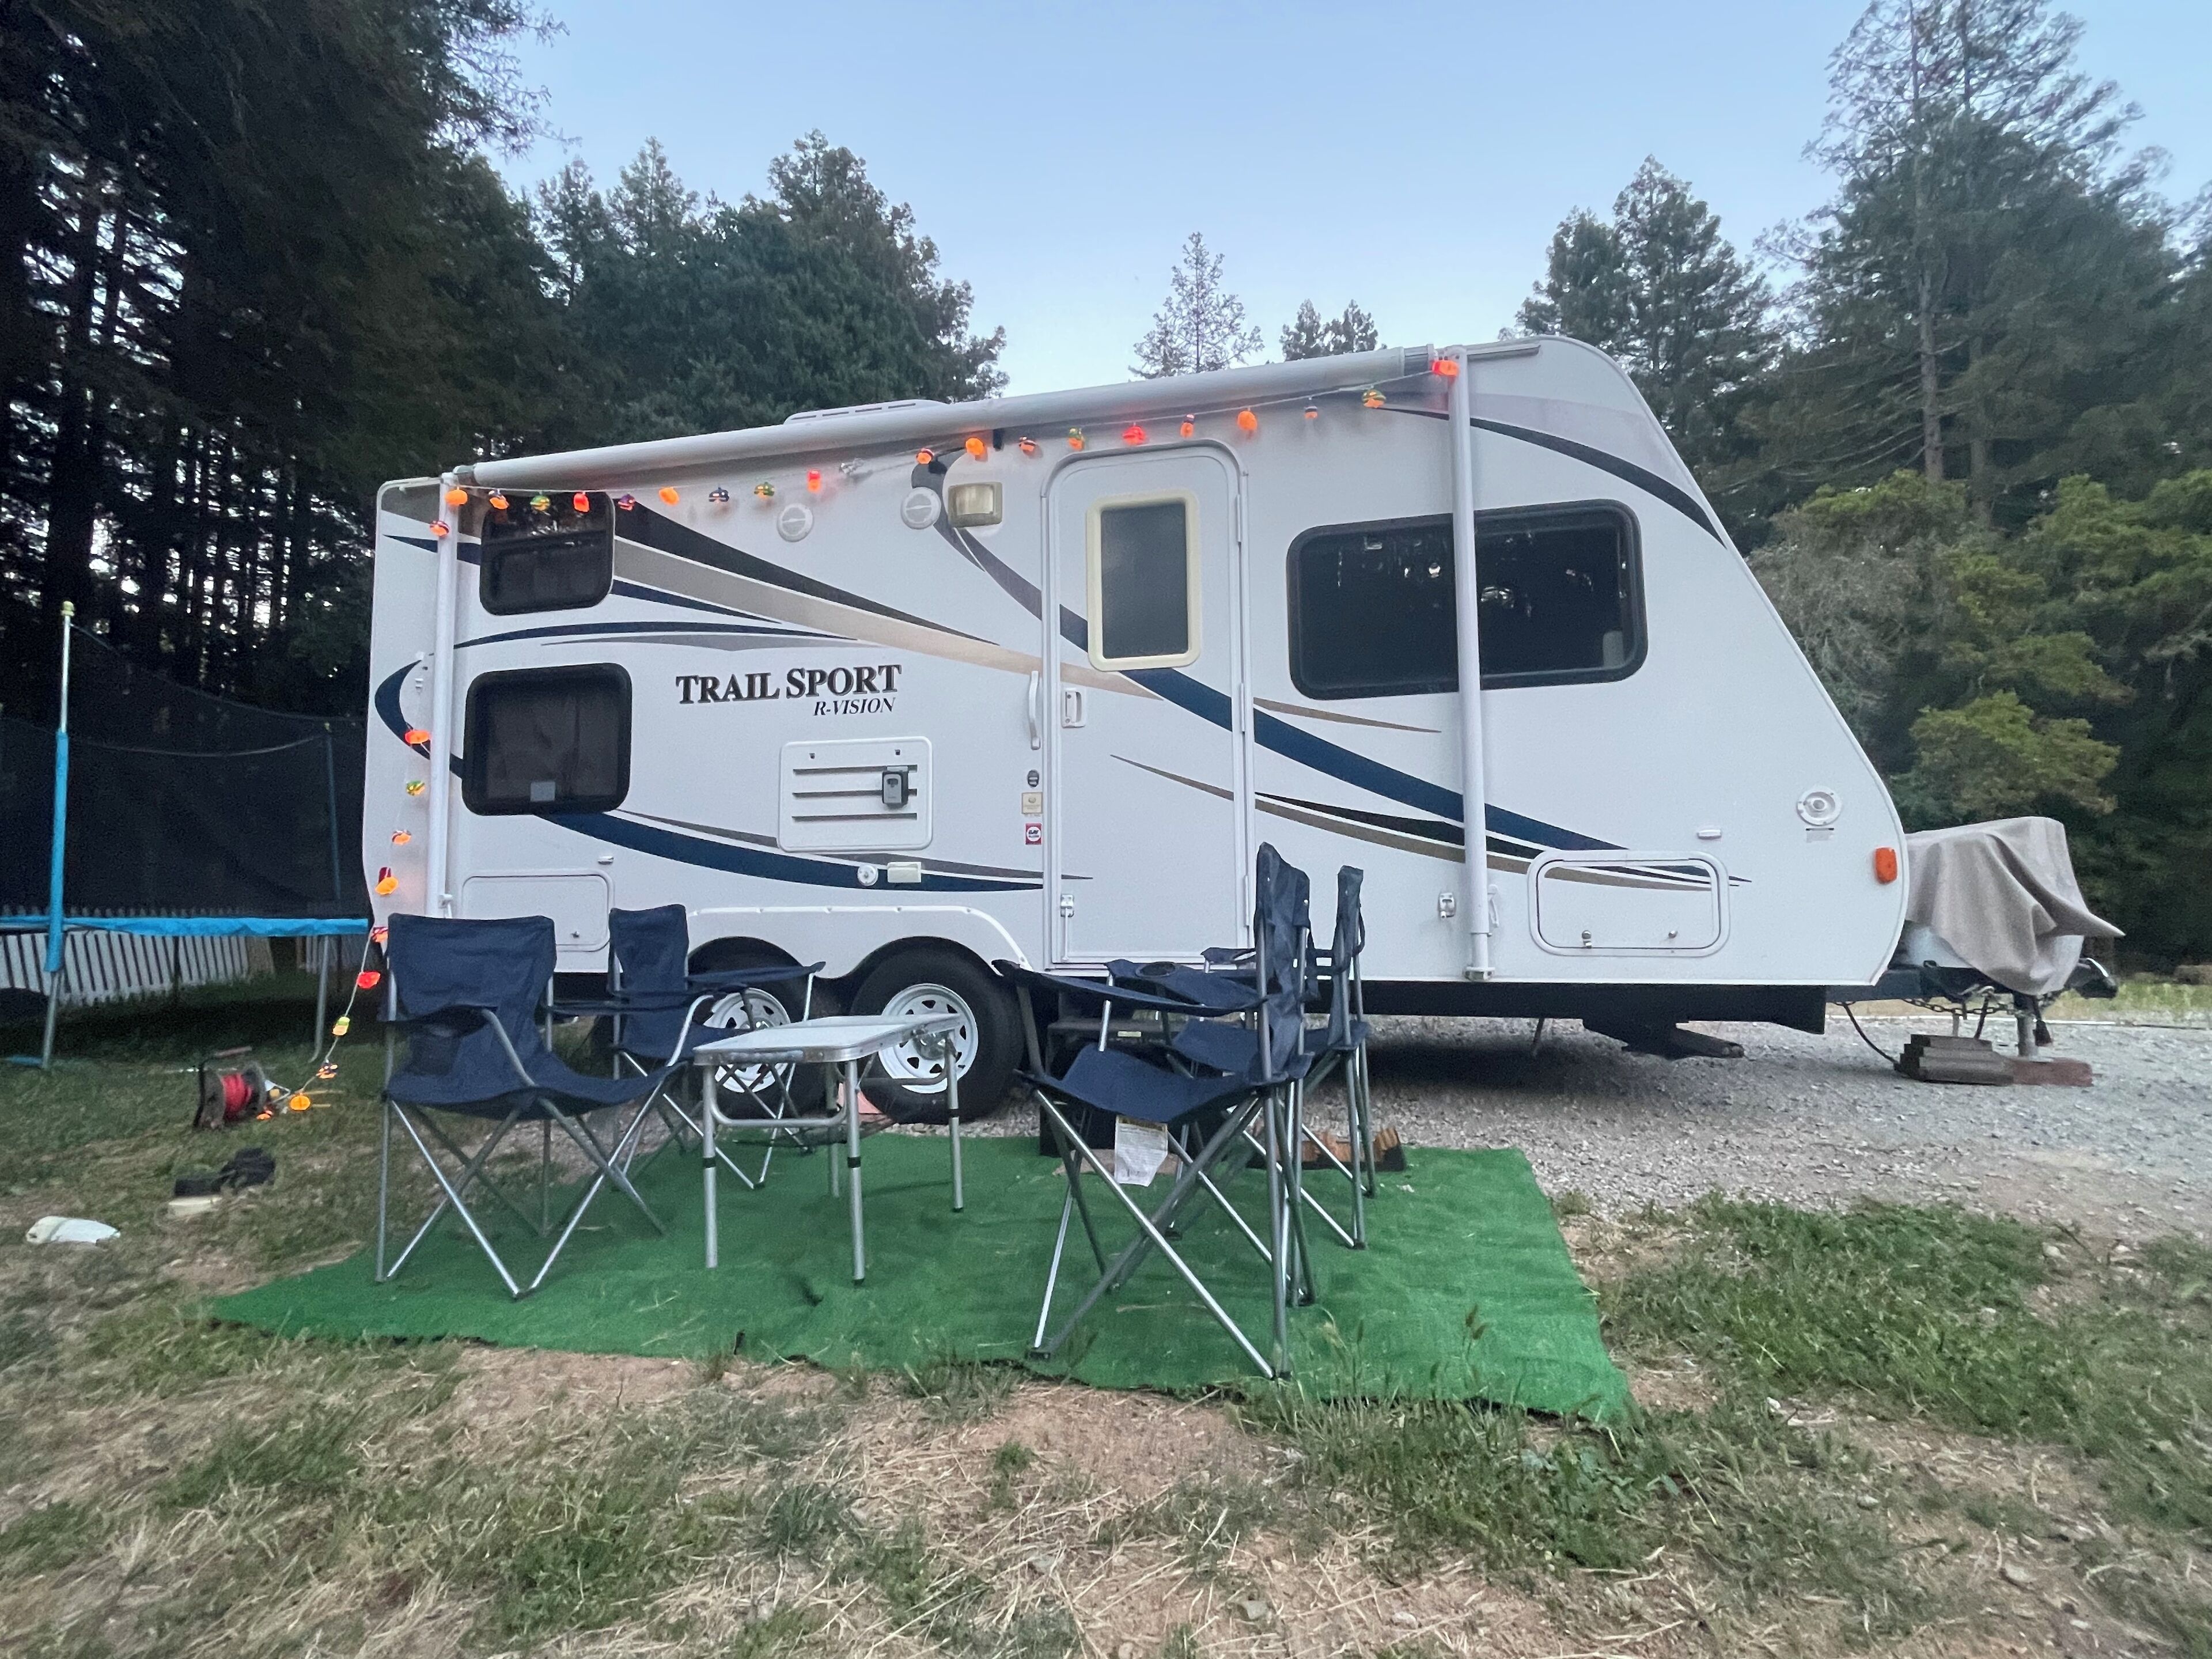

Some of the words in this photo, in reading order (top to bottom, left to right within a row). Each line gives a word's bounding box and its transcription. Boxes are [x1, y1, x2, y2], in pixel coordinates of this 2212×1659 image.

[676, 673, 779, 704] TRAIL
[786, 665, 902, 699] SPORT
[813, 697, 895, 716] R-VISION
